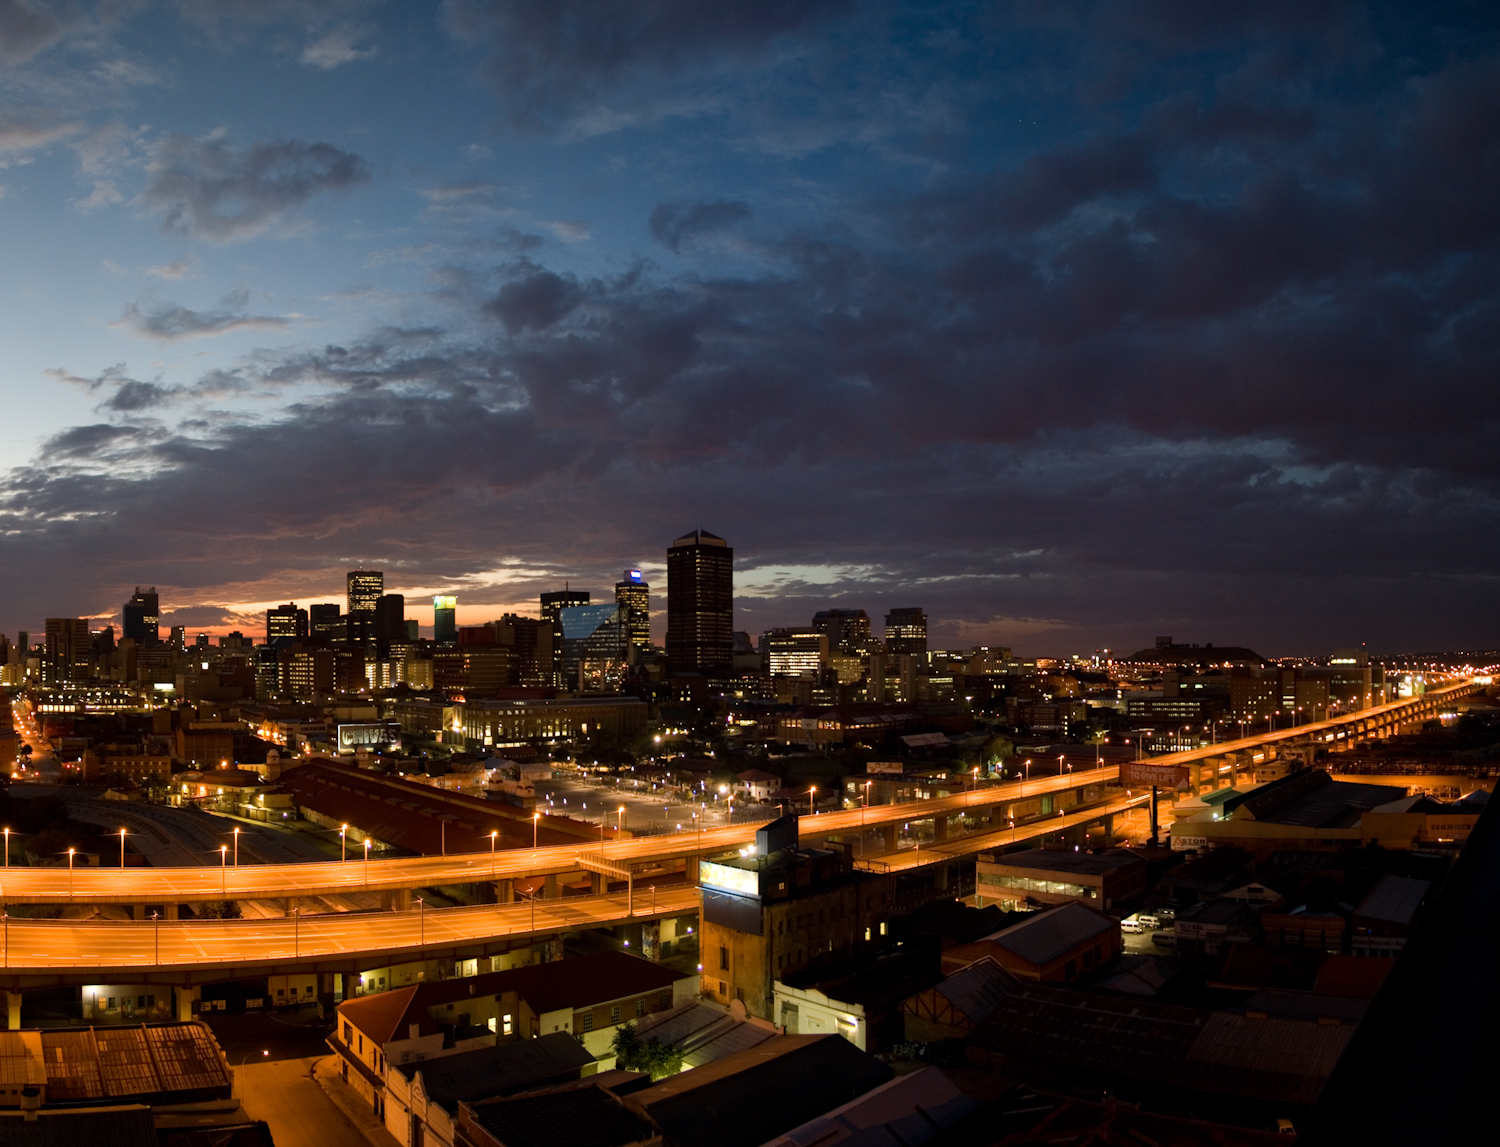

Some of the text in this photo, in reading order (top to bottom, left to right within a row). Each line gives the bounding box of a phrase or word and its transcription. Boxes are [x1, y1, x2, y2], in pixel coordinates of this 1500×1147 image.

[342, 728, 397, 745] CHIVAS
[1130, 771, 1176, 783] TO GIVE LIFE
[1179, 922, 1204, 931] GLOBAL
